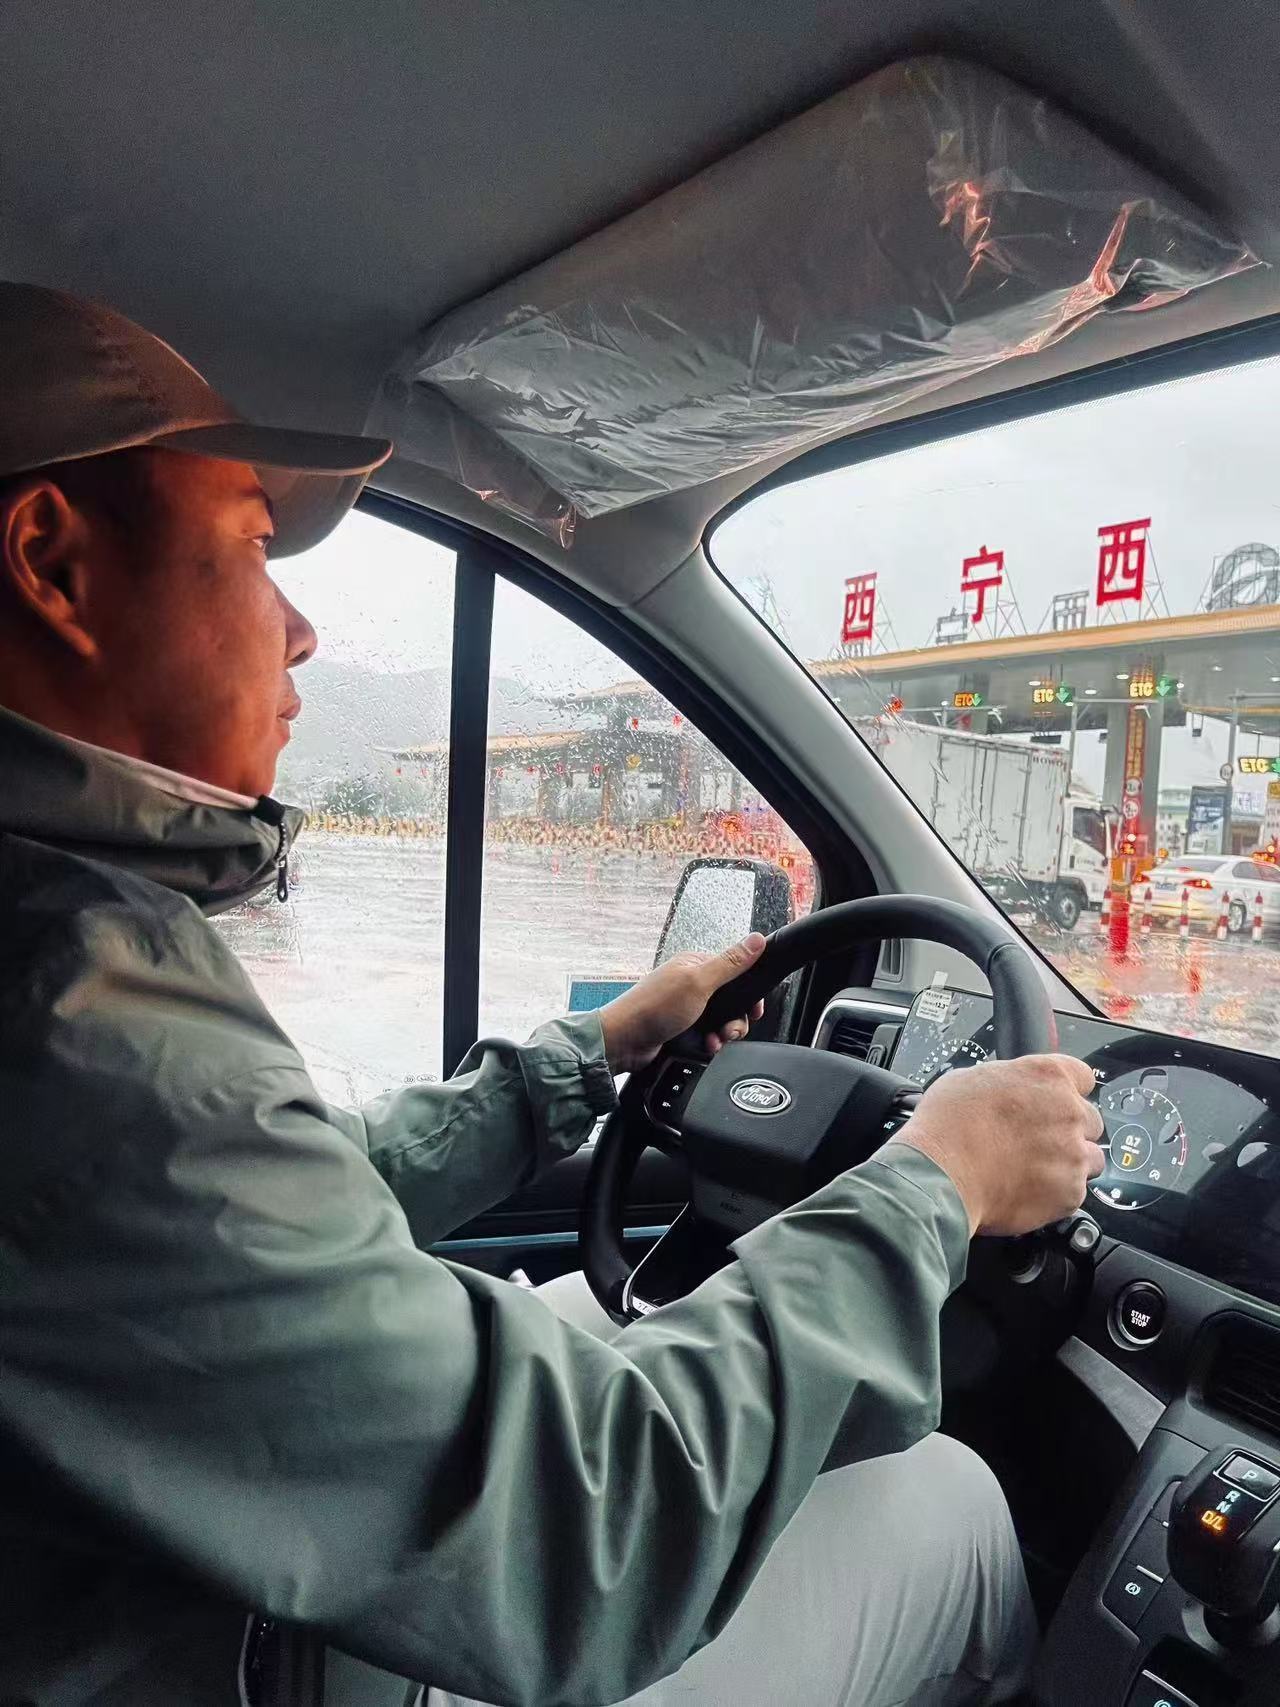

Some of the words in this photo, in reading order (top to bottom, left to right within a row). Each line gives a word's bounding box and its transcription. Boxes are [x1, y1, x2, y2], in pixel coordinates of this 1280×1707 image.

[842, 517, 1151, 644] 西宁西
[1033, 688, 1054, 703] ETC
[1130, 682, 1153, 698] ETC
[1240, 758, 1269, 773] ETC
[741, 1084, 776, 1106] Ford
[1125, 1135, 1141, 1148] 0.7
[1121, 1152, 1132, 1167] D
[1131, 1310, 1151, 1323] START
[1131, 1317, 1147, 1327] STOP
[1242, 1470, 1258, 1480] P
[1225, 1490, 1241, 1502] R
[1216, 1501, 1232, 1513] N
[1201, 1510, 1223, 1531] D/L
